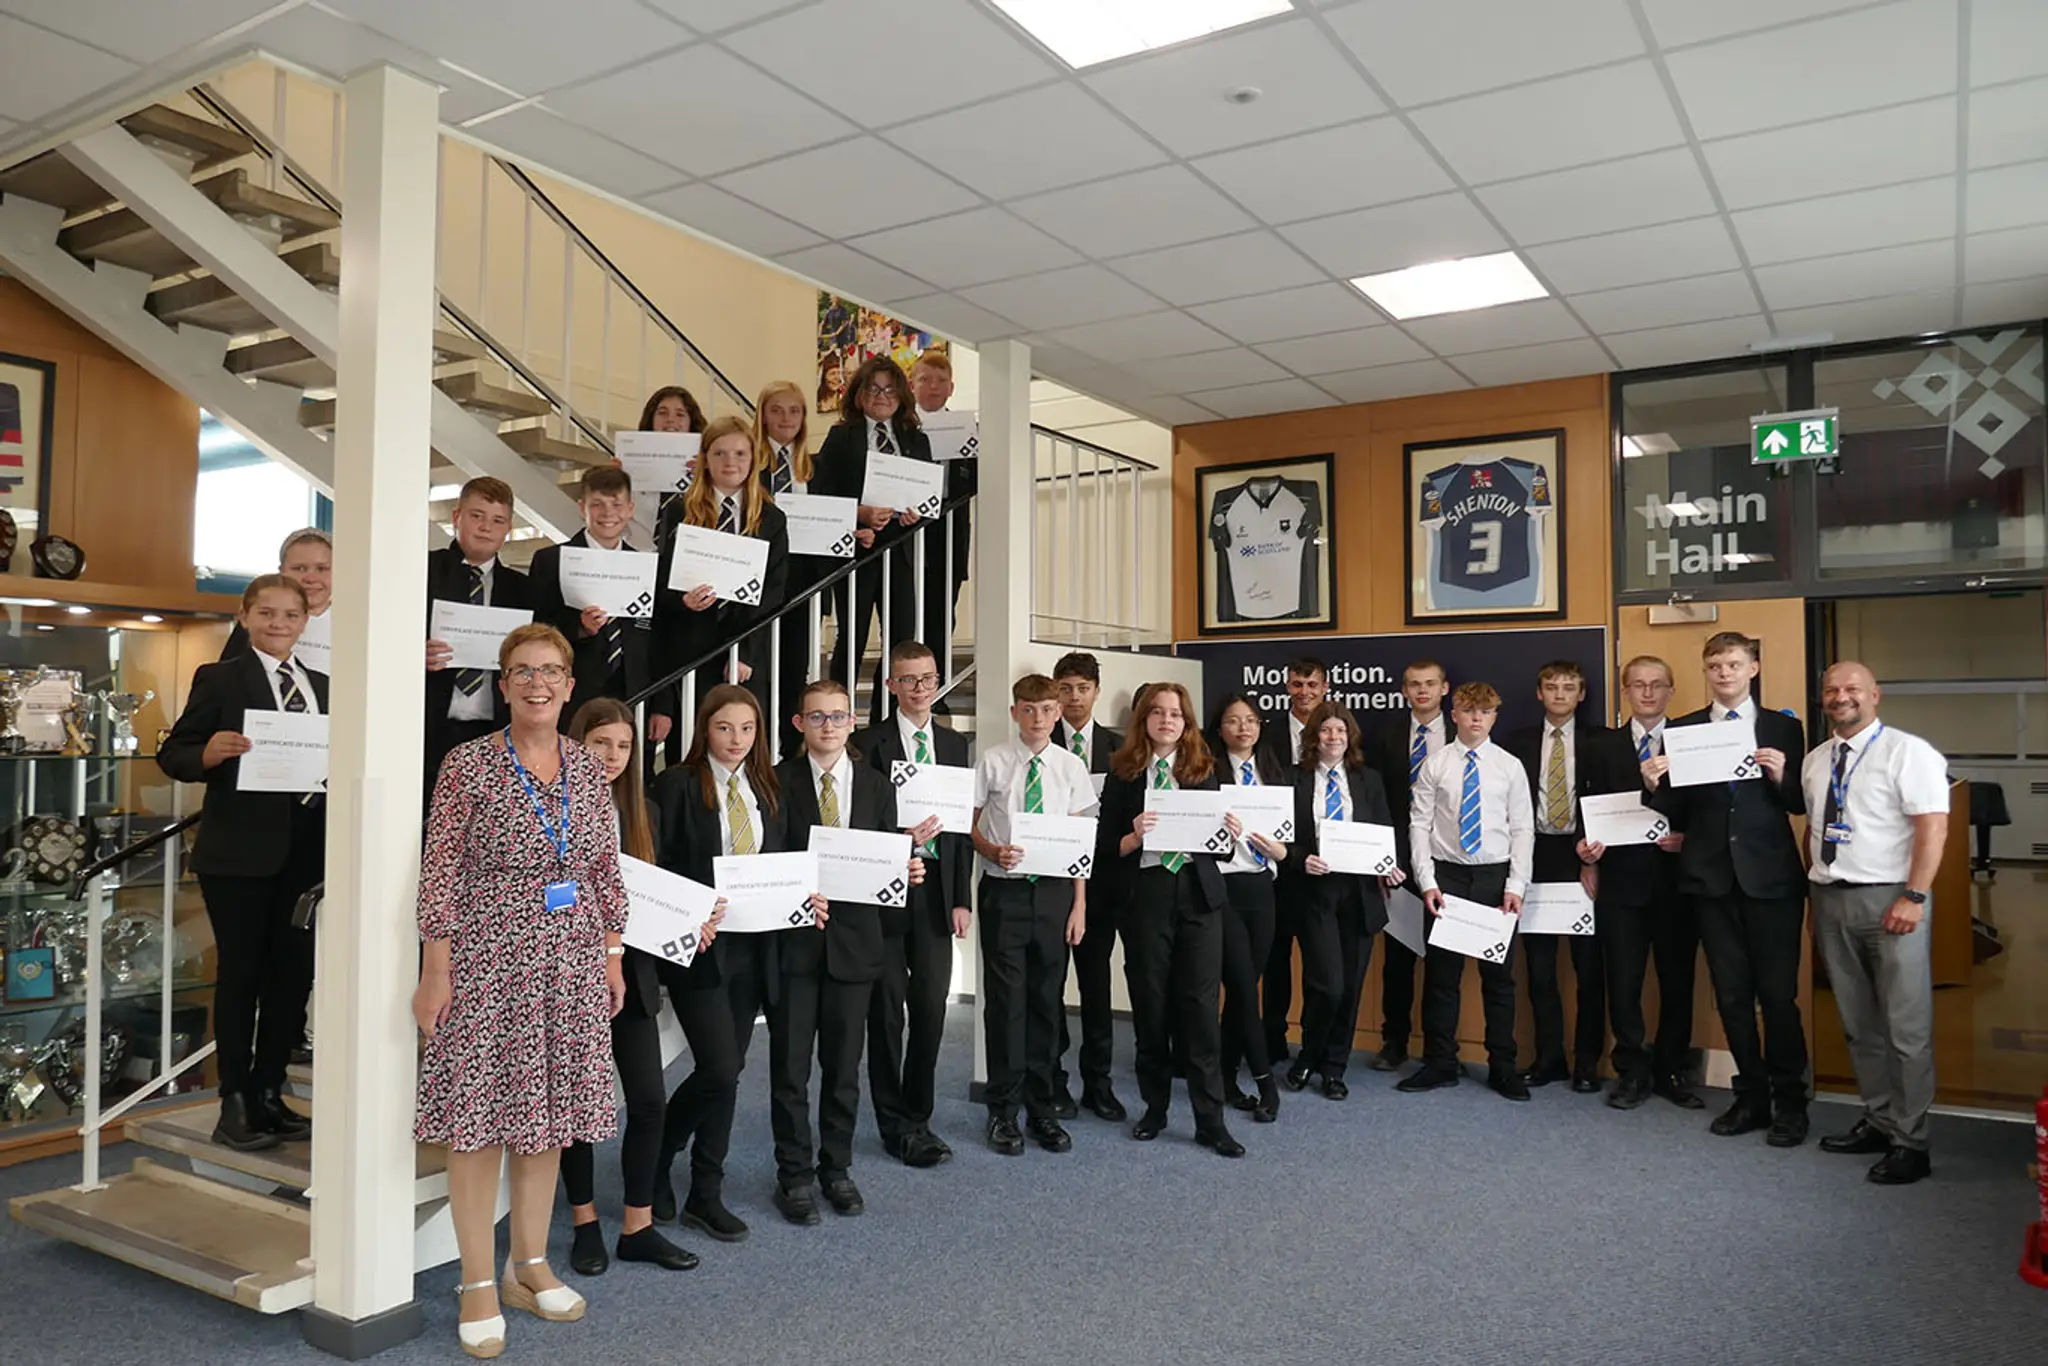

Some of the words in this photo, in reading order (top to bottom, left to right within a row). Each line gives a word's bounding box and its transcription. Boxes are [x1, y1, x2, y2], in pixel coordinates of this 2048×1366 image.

[1446, 493, 1521, 528] SHENTON
[1646, 485, 1767, 529] Main
[1465, 520, 1504, 576] 3
[1646, 532, 1739, 576] Hall
[1243, 662, 1393, 688] Mottion.
